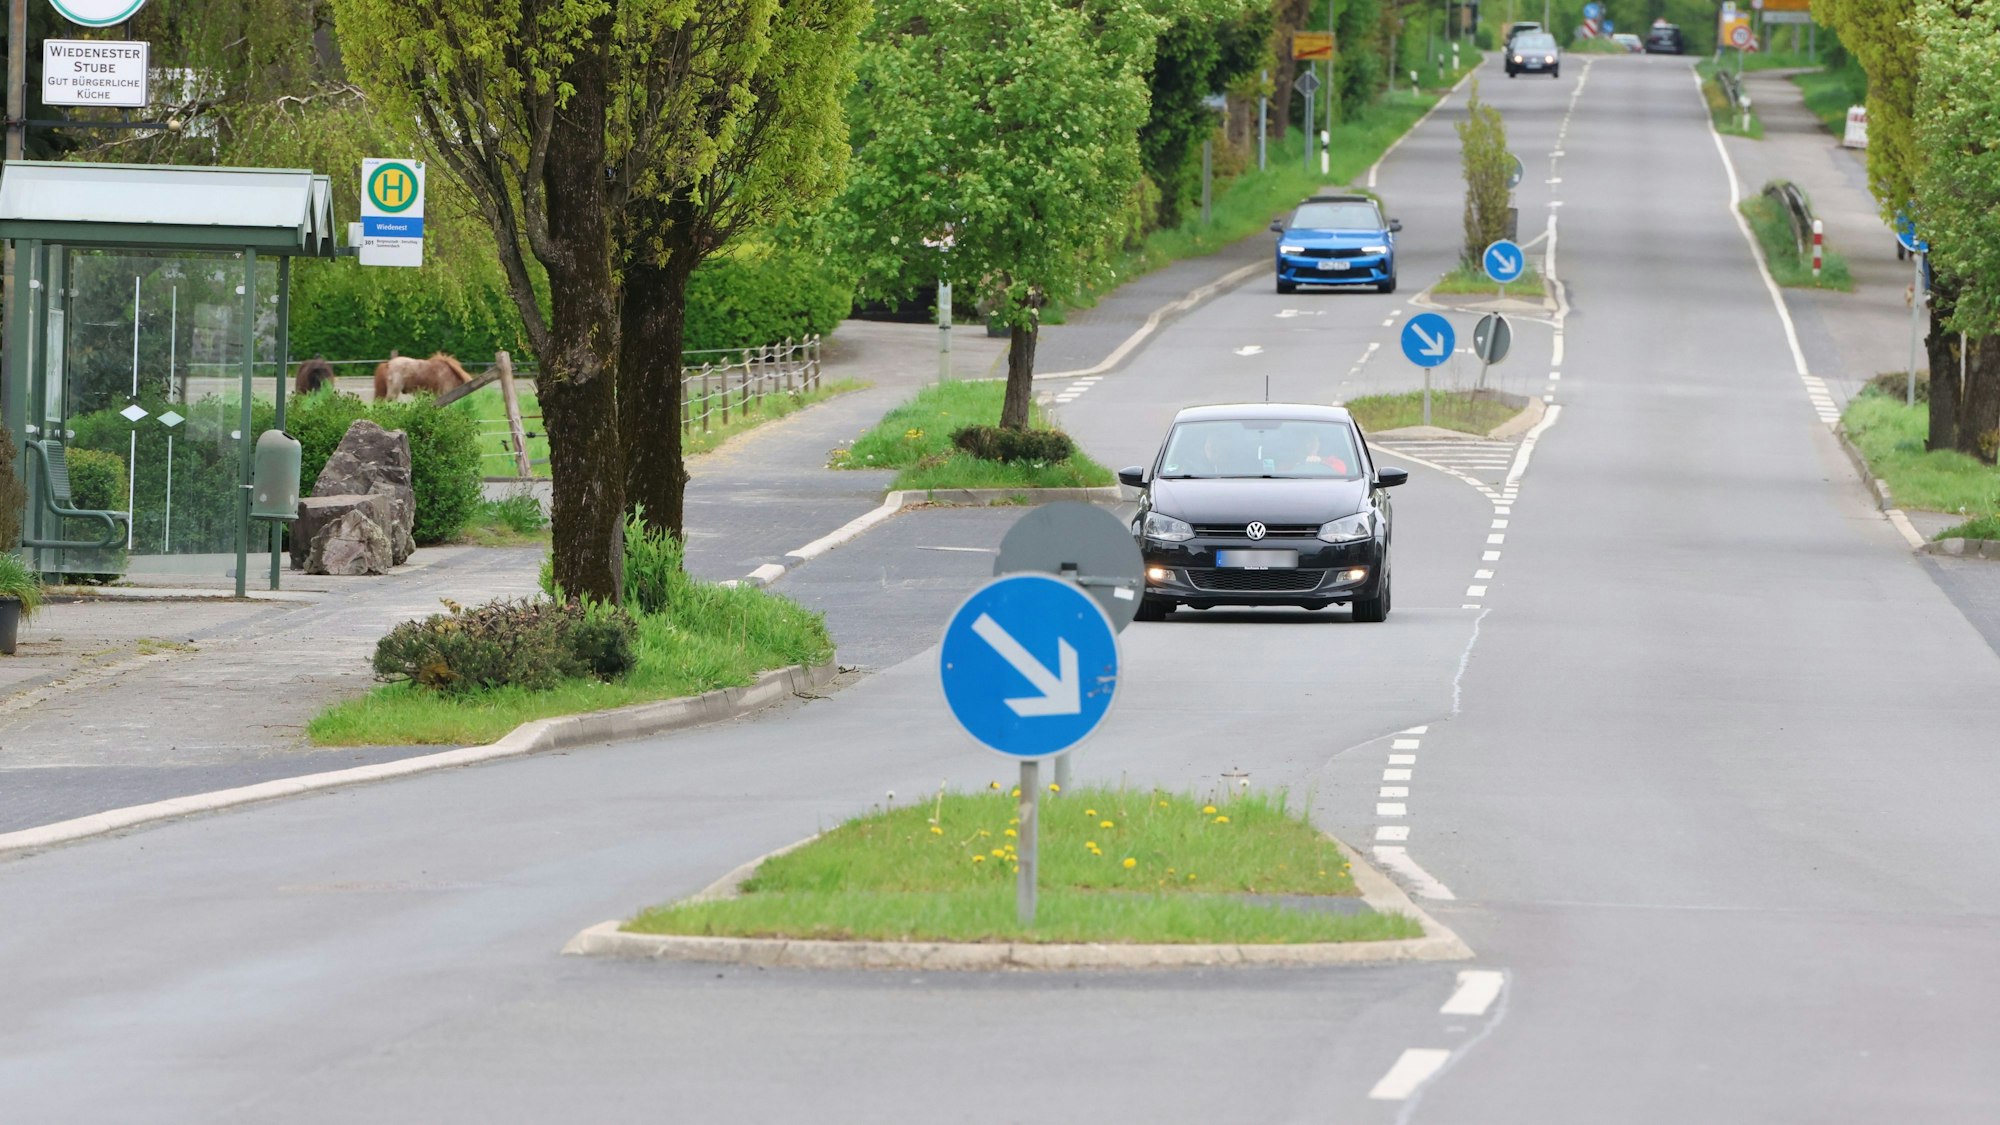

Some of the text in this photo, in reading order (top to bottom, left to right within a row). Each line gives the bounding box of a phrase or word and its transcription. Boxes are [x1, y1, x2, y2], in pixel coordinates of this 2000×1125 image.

[49, 45, 140, 59] WIEDENESTER
[74, 61, 116, 73] STUBE
[48, 75, 140, 88] GUT BÜRGERLICHE
[77, 88, 111, 100] KÜCHE
[383, 174, 404, 202] H
